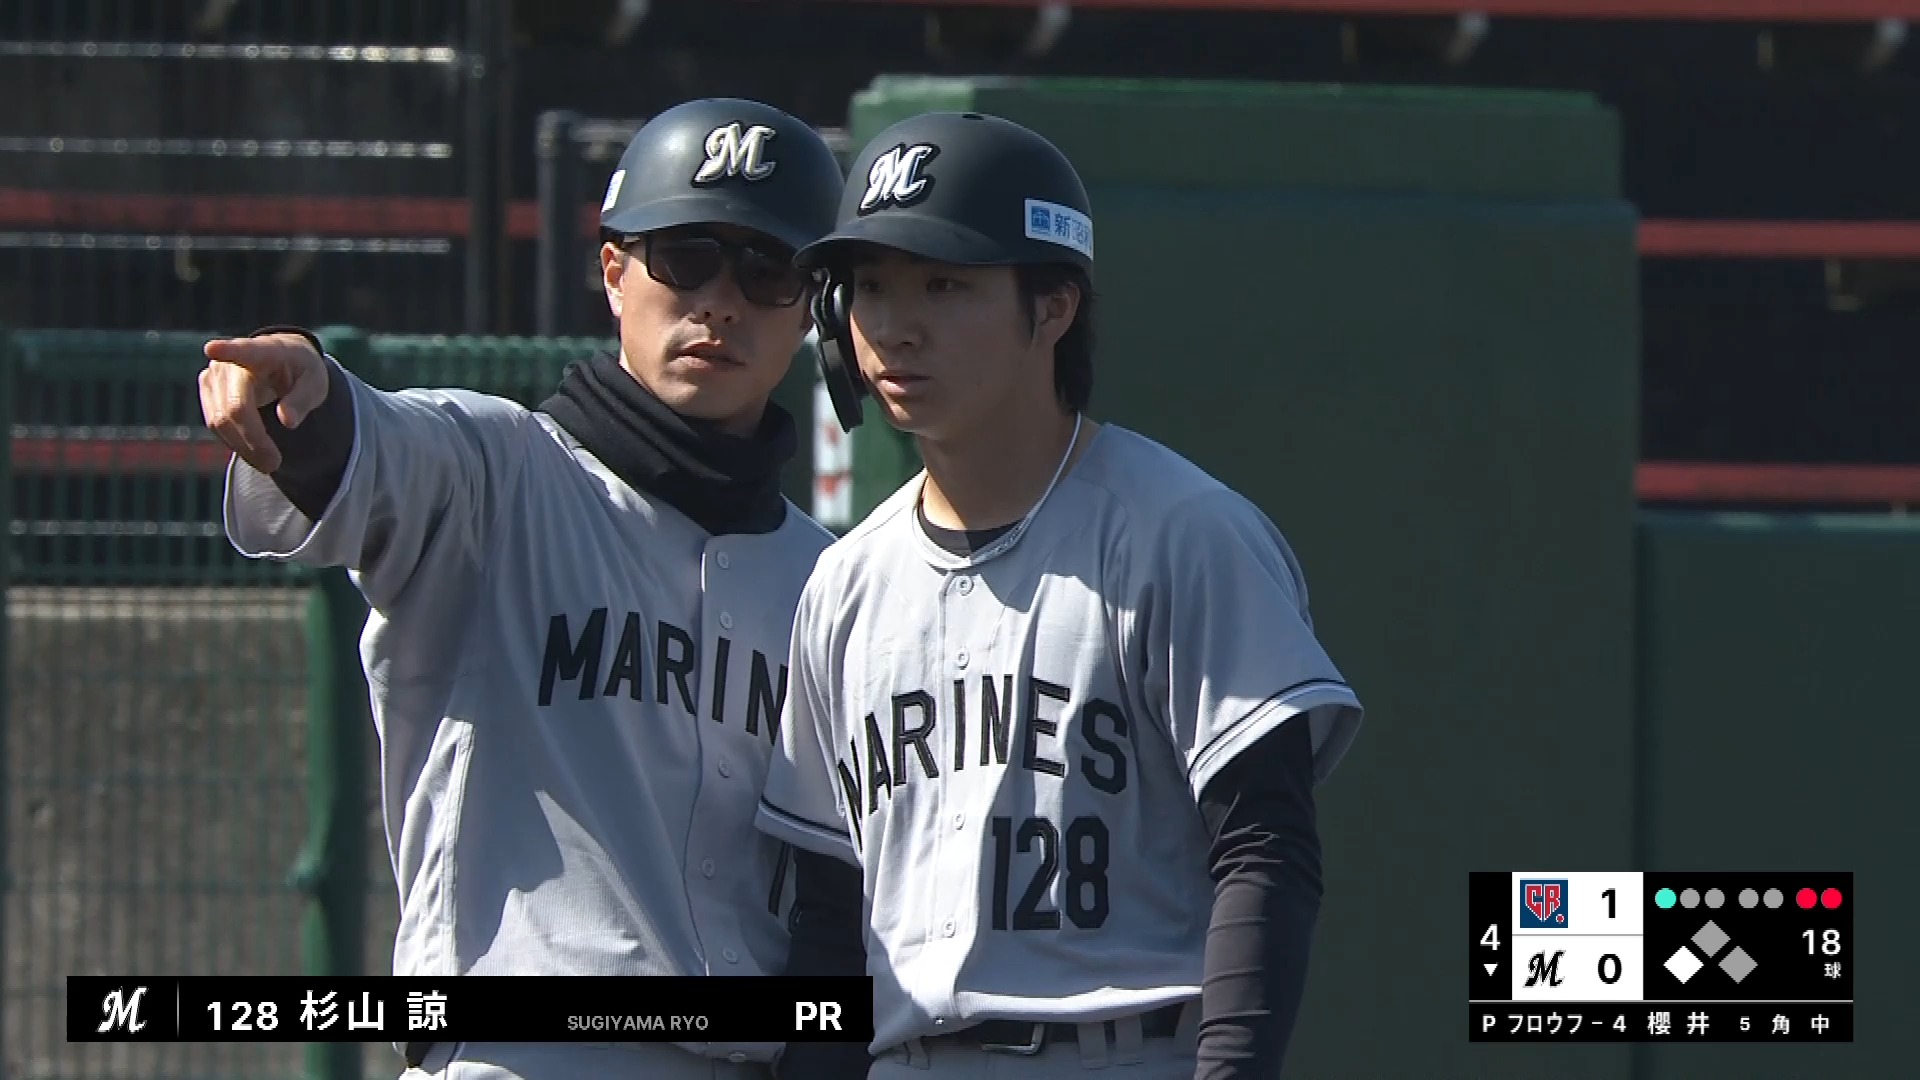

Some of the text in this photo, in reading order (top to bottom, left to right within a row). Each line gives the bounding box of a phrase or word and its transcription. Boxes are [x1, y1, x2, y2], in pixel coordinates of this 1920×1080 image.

[693, 122, 777, 187] M
[859, 143, 941, 216] M
[991, 816, 1111, 931] 128
